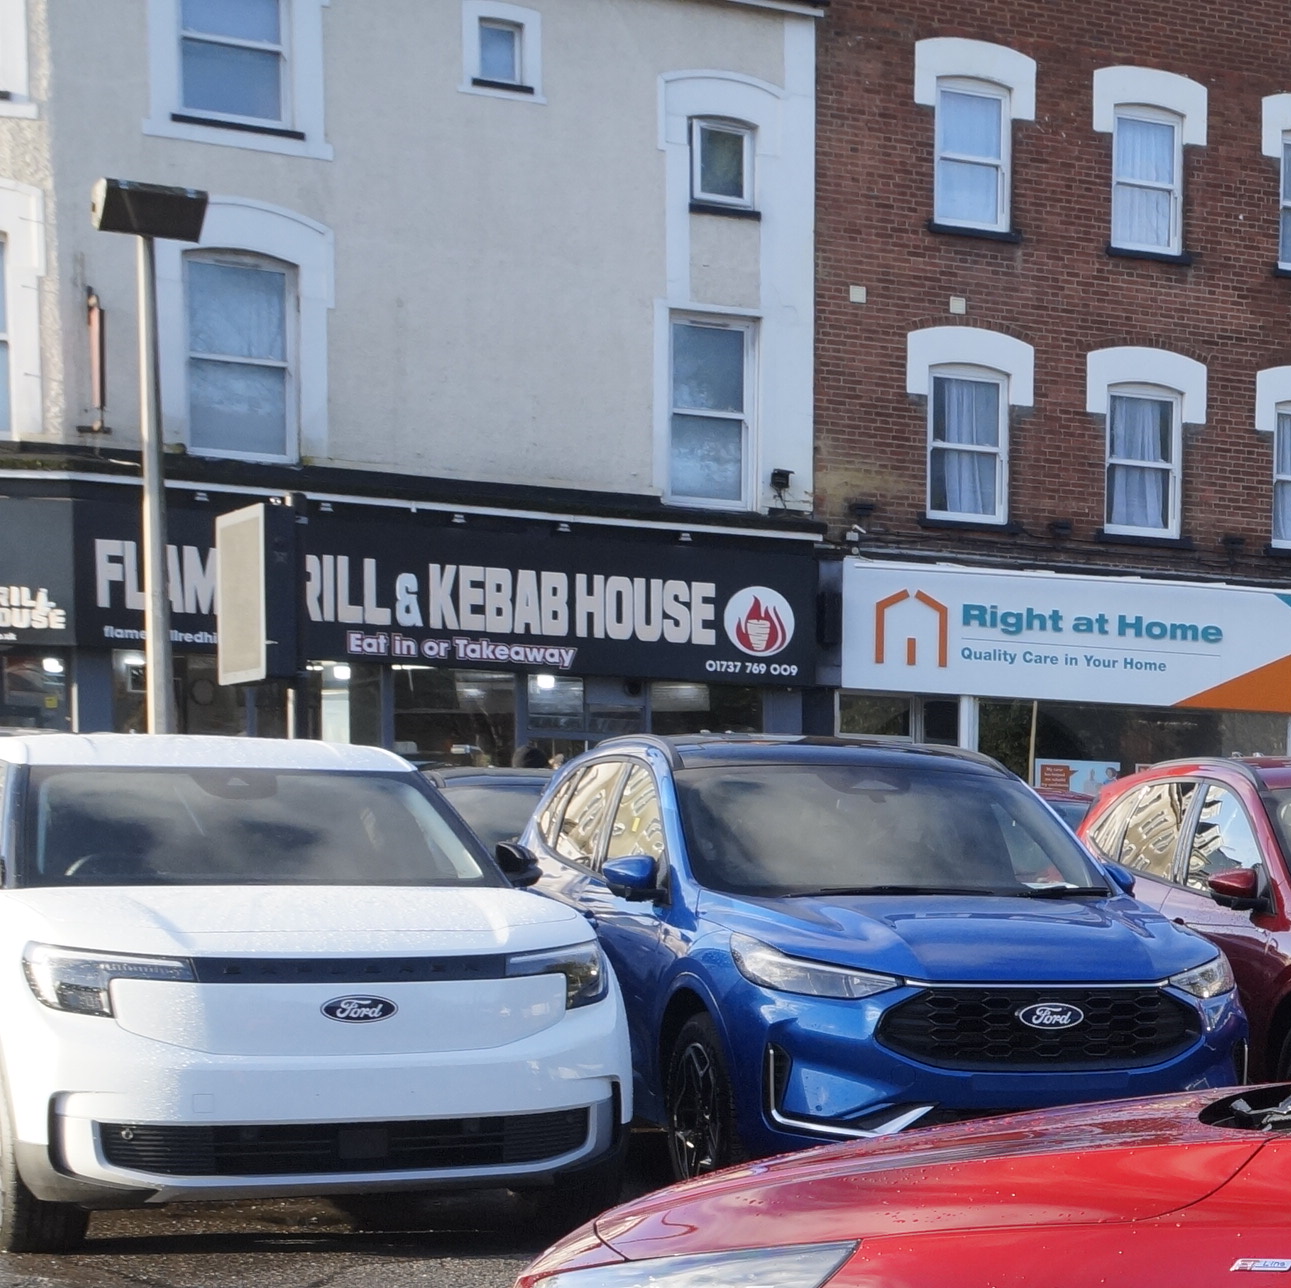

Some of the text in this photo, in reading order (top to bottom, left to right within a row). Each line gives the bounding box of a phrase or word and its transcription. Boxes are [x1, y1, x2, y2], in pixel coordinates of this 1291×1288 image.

[395, 572, 424, 627] &
[428, 563, 569, 637] KEBAB
[575, 573, 717, 645] HOUSE
[961, 603, 1224, 643] Right at Home
[347, 630, 578, 668] Eat in or Takeaway
[960, 646, 1167, 672] Quality Care in Your Home
[705, 660, 741, 674] 01737
[745, 662, 767, 675] 769
[335, 999, 384, 1018] Ford
[1032, 1006, 1072, 1024] Ford
